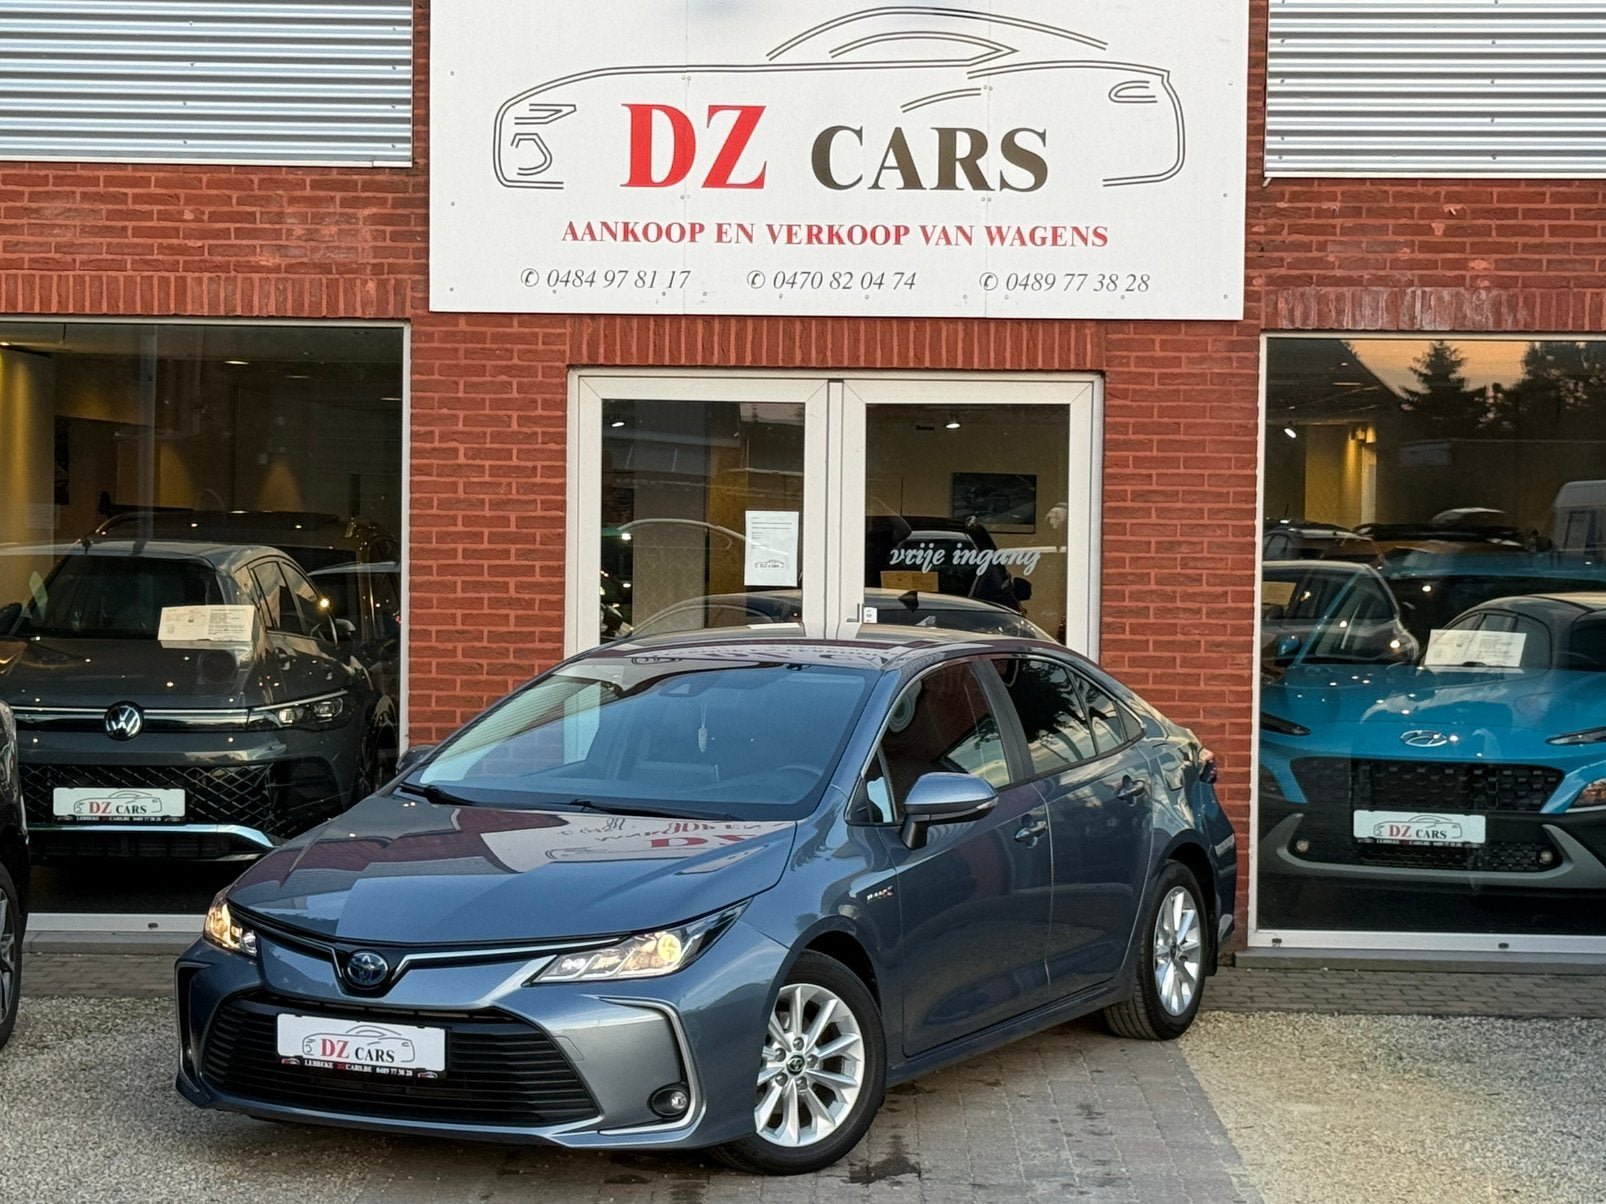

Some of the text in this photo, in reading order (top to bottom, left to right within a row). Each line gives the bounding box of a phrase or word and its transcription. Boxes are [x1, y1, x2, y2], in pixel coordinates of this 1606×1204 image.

[620, 104, 1048, 192] DZ CARS
[562, 221, 1107, 247] AANKOOP EN VERKOOP VAN WAGENS
[547, 270, 691, 288] 0484 97 81 17
[774, 271, 916, 290] 0470 82 04 74
[1006, 273, 1150, 291] 0489 77 38 28
[889, 542, 1041, 576] vrije ingang
[89, 801, 147, 814] DZ CARS
[1389, 824, 1447, 839] DZ CARS
[320, 1038, 395, 1064] DZ CARS
